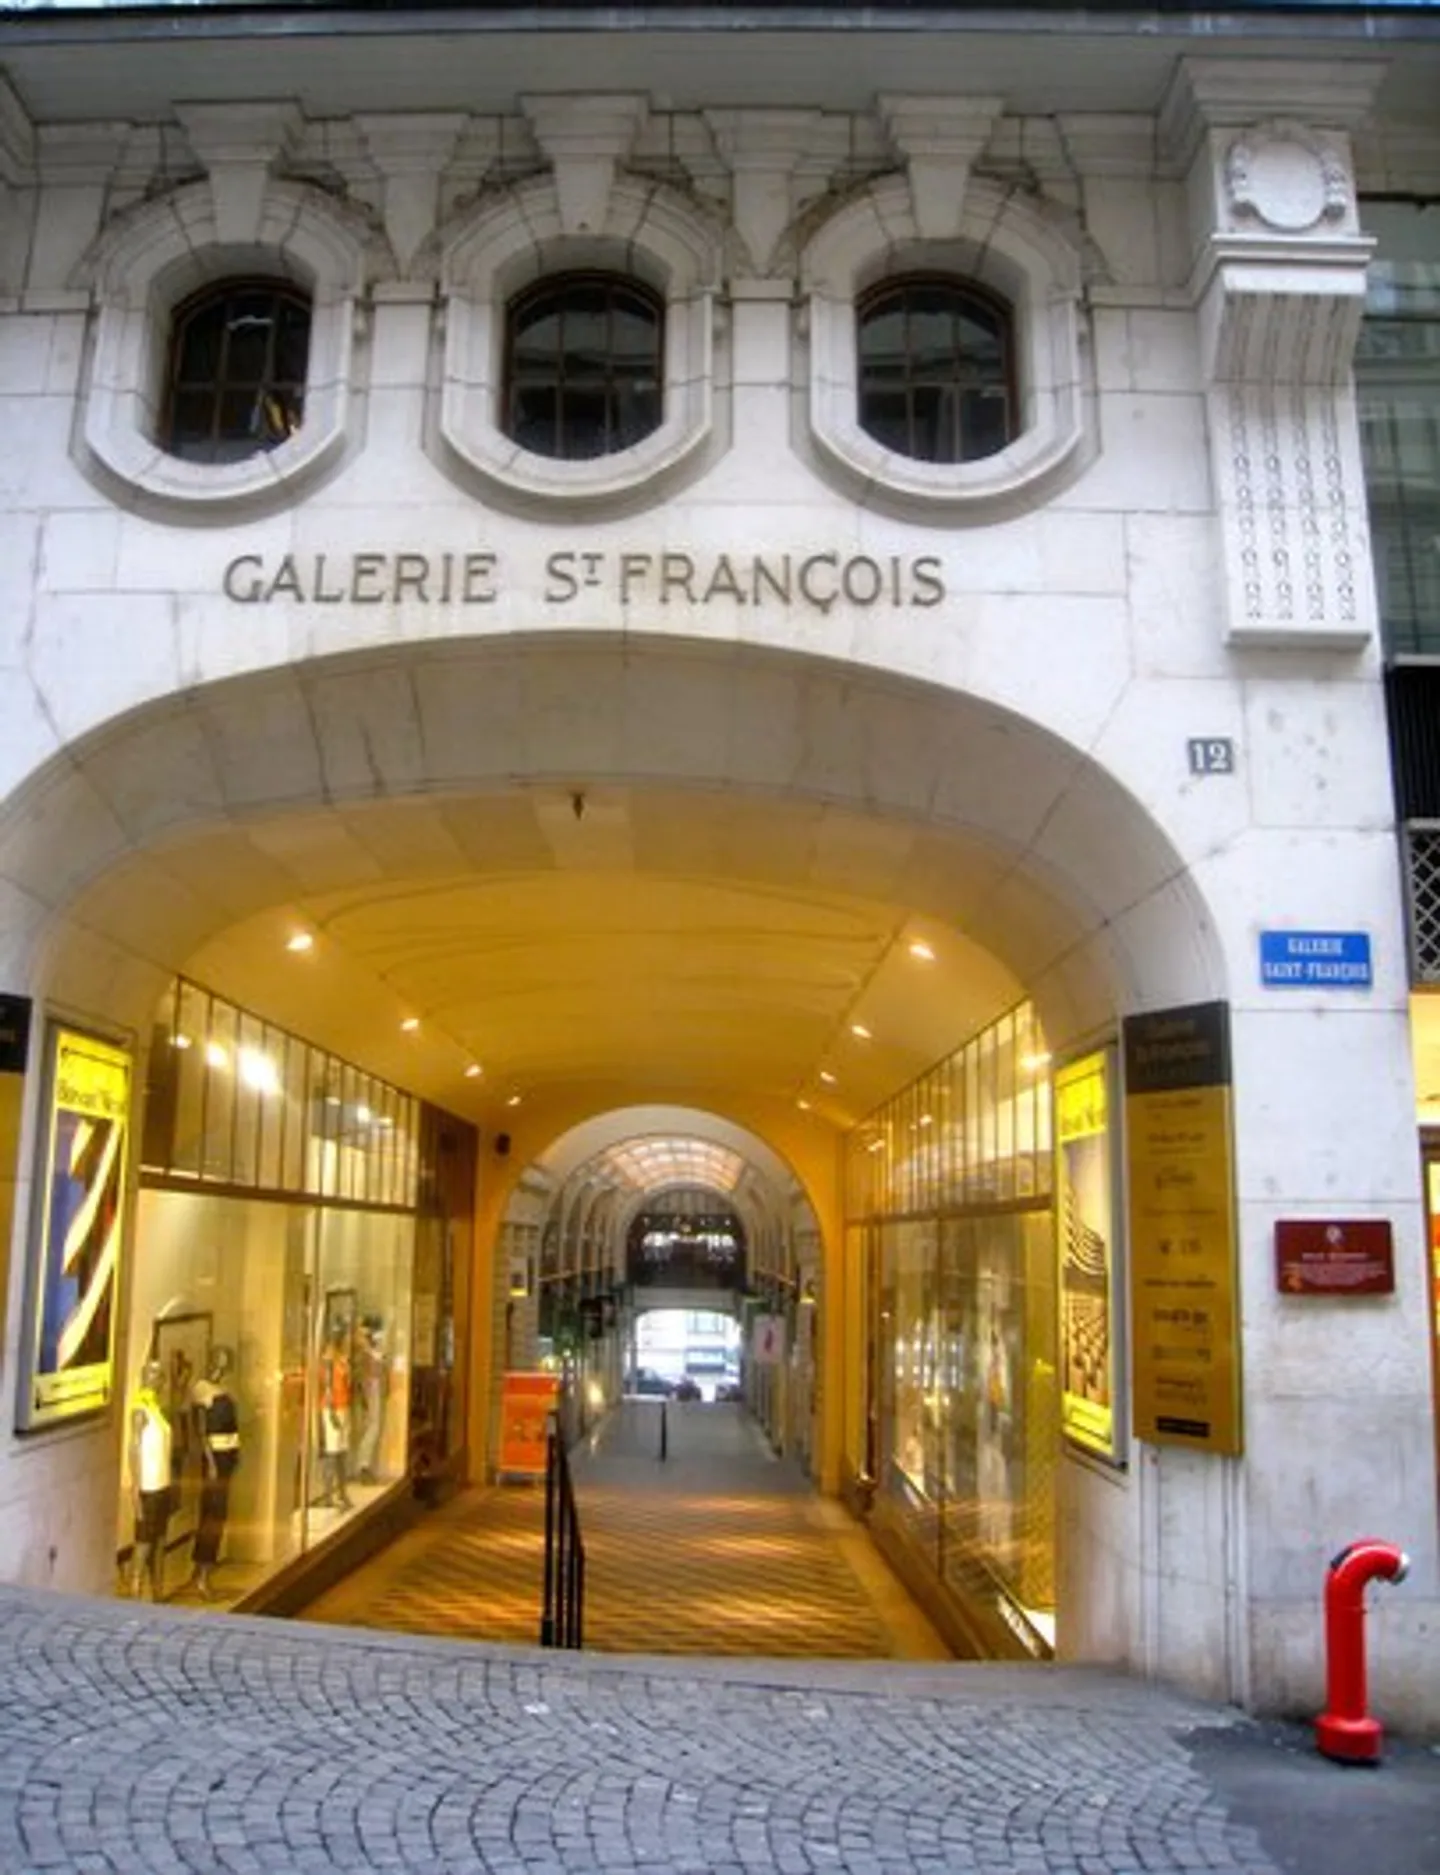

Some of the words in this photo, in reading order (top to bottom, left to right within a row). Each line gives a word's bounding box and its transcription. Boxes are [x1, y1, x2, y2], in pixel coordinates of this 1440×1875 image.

[223, 552, 498, 605] GALERIE
[619, 552, 948, 615] FRANÇOIS
[1193, 743, 1227, 770] 12
[1286, 937, 1343, 956] GALERIE
